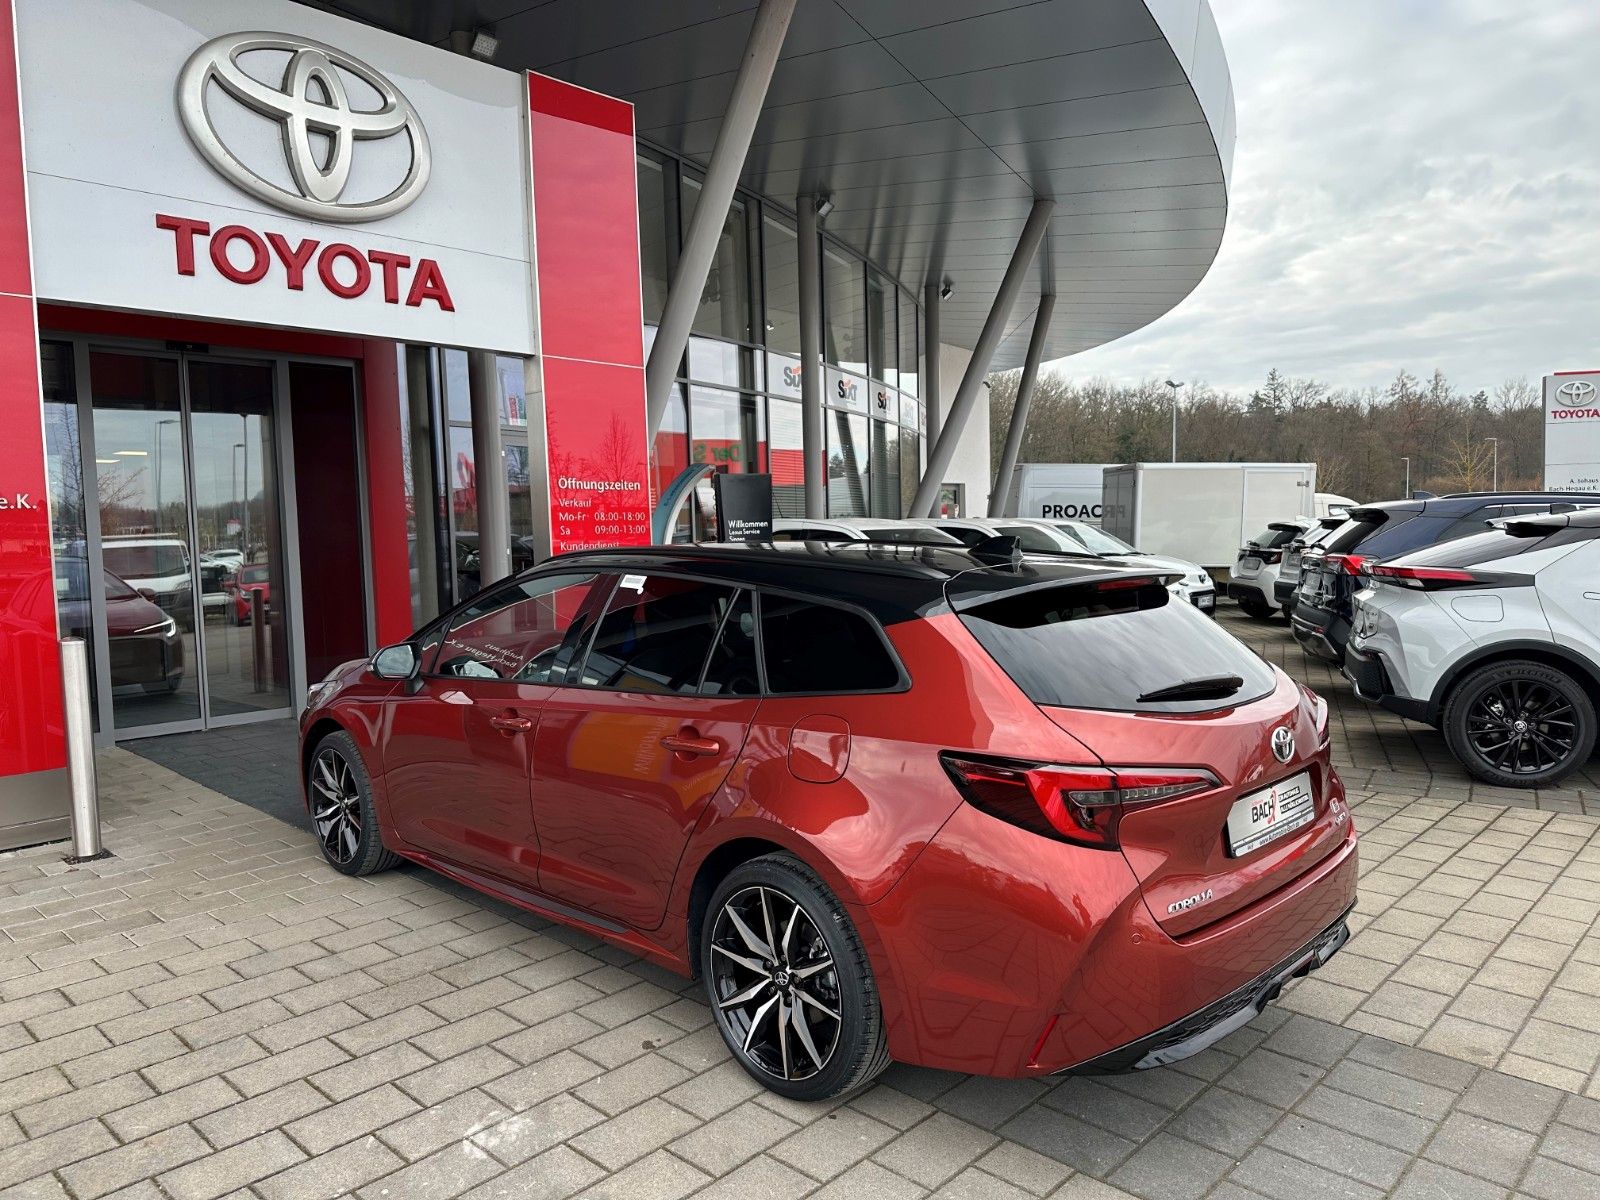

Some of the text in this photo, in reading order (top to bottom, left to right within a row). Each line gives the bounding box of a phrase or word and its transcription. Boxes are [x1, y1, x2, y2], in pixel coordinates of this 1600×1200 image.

[155, 213, 455, 312] TOYOTA
[1551, 409, 1600, 420] TOYOTA
[558, 476, 640, 493] Öffnungszeiten
[0, 493, 37, 509] e.K.
[559, 498, 592, 508] Verkauf
[559, 512, 646, 521] Mo-Fr 08:00-18:00
[728, 519, 769, 528] Willkommen
[560, 525, 646, 536] Sa 09:00-13:00
[1251, 796, 1275, 824] BACH
